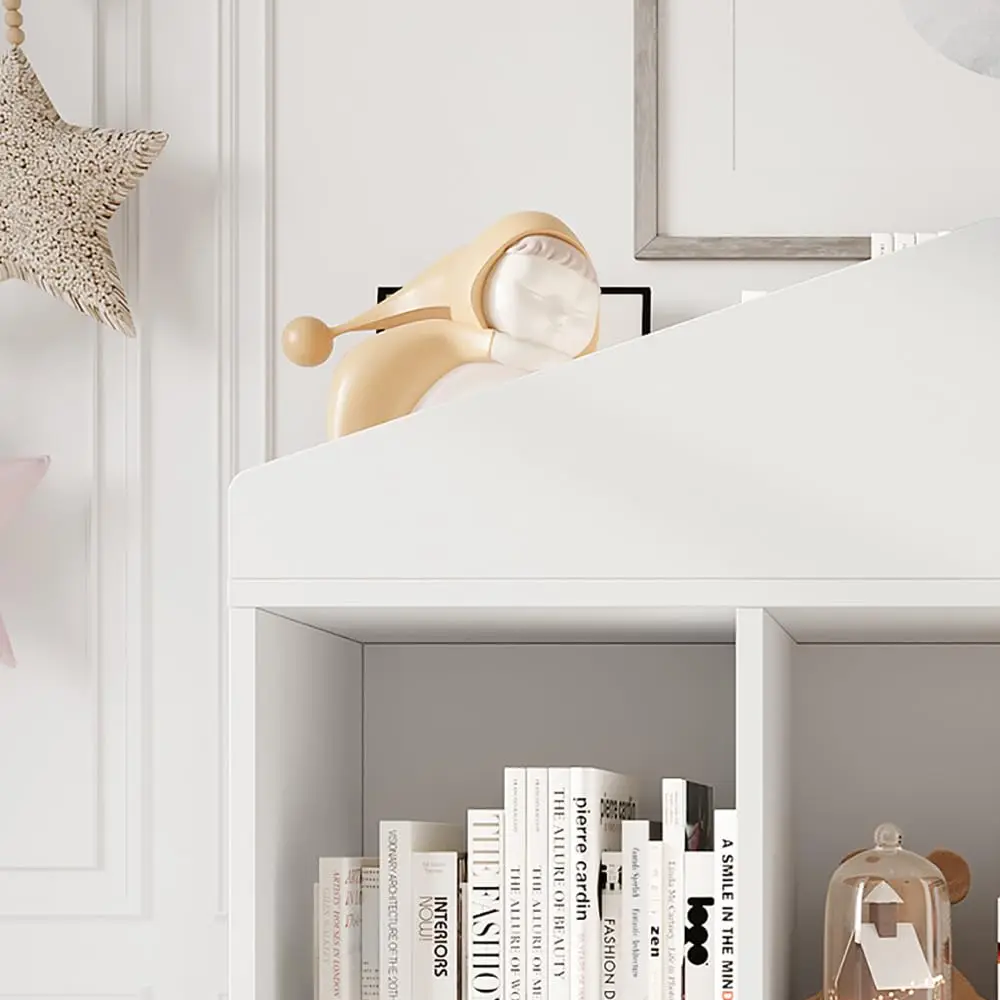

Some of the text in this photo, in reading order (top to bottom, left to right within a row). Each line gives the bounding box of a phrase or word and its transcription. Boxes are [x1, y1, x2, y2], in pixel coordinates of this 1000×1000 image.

[472, 814, 500, 877] THE
[573, 796, 591, 921] pierre cardin
[722, 838, 734, 849] A
[510, 866, 521, 895] THE
[532, 866, 543, 896] THE
[553, 787, 566, 981] THE ALLURE OF BEAUTY
[722, 853, 734, 901] SMILE
[387, 873, 399, 941] ARCHITECTURE
[419, 896, 433, 942] NOW!
[510, 898, 521, 954] ALLURE
[532, 898, 543, 954] ALLURE
[722, 906, 734, 921] IN
[387, 943, 399, 957] OF
[434, 896, 448, 978] INTERIORS
[603, 918, 616, 985] FASHION
[650, 926, 660, 957] zen
[722, 925, 734, 956] THE
[332, 959, 341, 998] LONDON
[387, 957, 399, 976] THE
[510, 956, 521, 973] OF
[532, 956, 543, 973] OF
